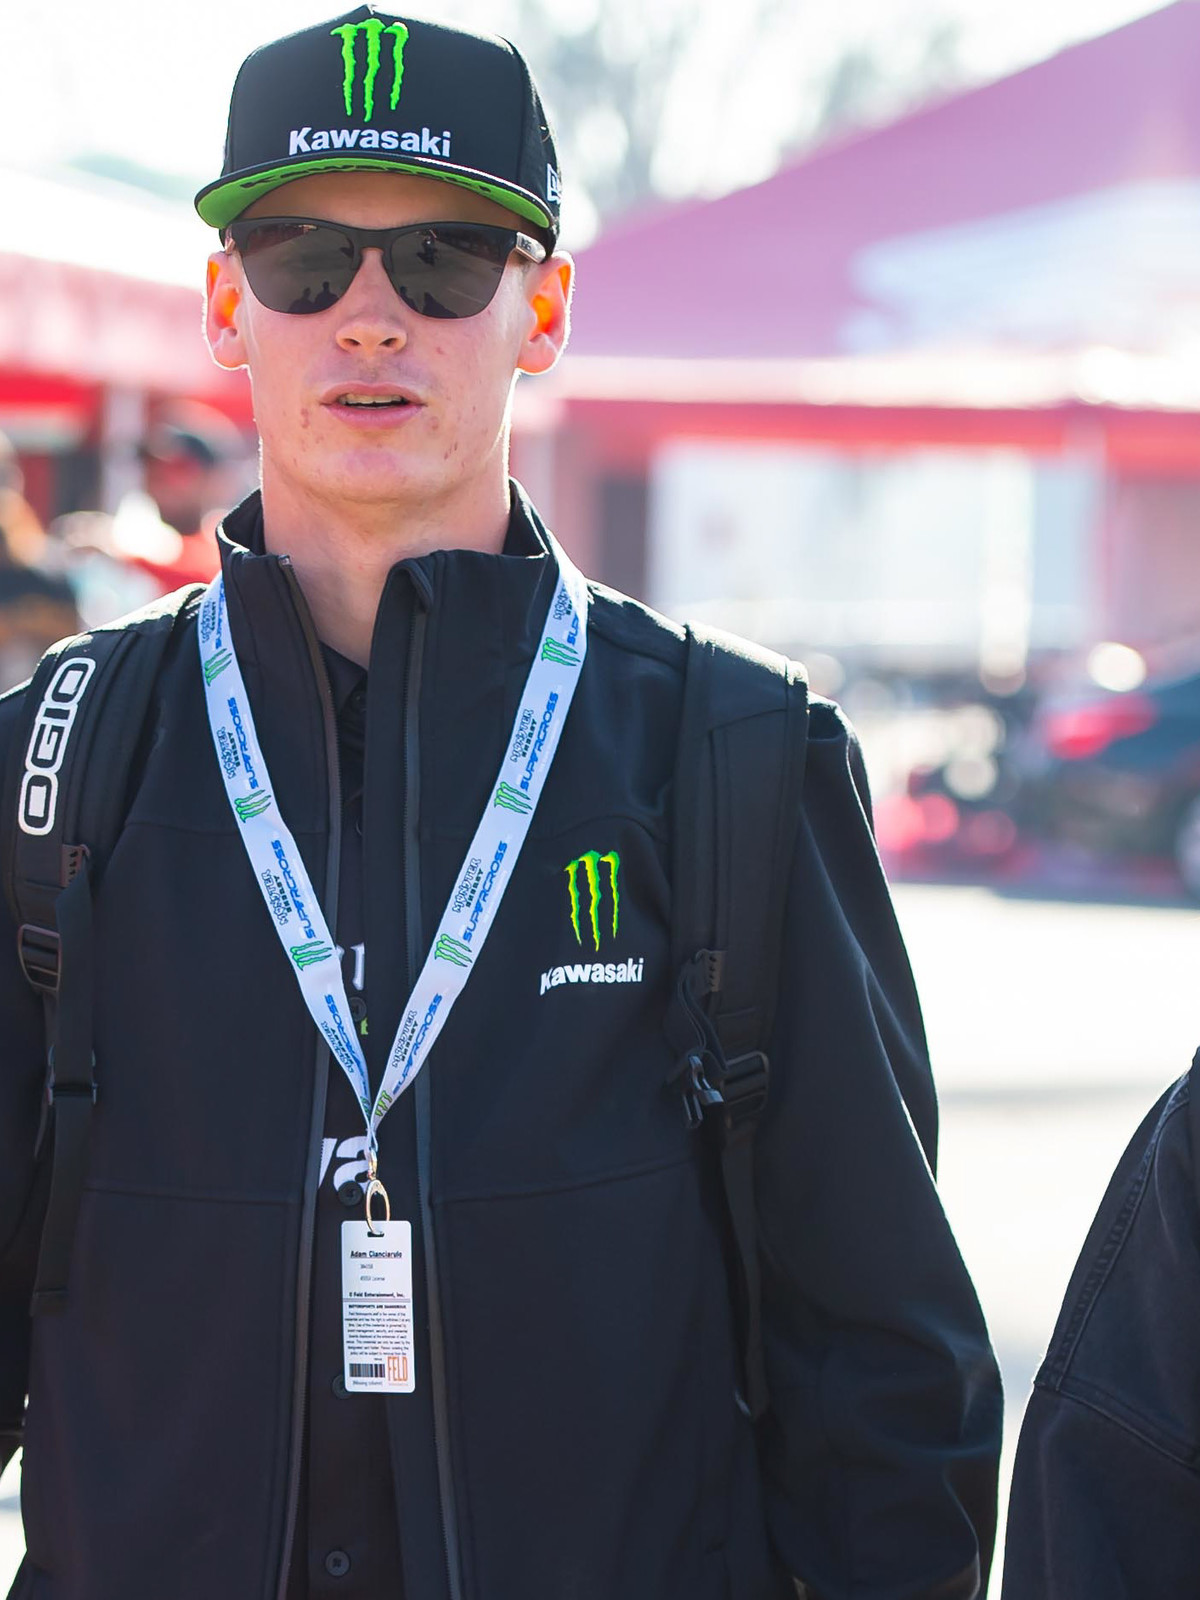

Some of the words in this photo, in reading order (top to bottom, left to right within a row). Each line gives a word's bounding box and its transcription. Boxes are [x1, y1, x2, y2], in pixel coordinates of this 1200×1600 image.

[289, 127, 451, 158] Kawasaki
[18, 657, 96, 836] OGIO
[463, 840, 508, 942] SUPERCROSS
[540, 957, 645, 996] Kawasaki
[350, 1250, 367, 1258] Adam
[387, 1356, 408, 1381] FELD
